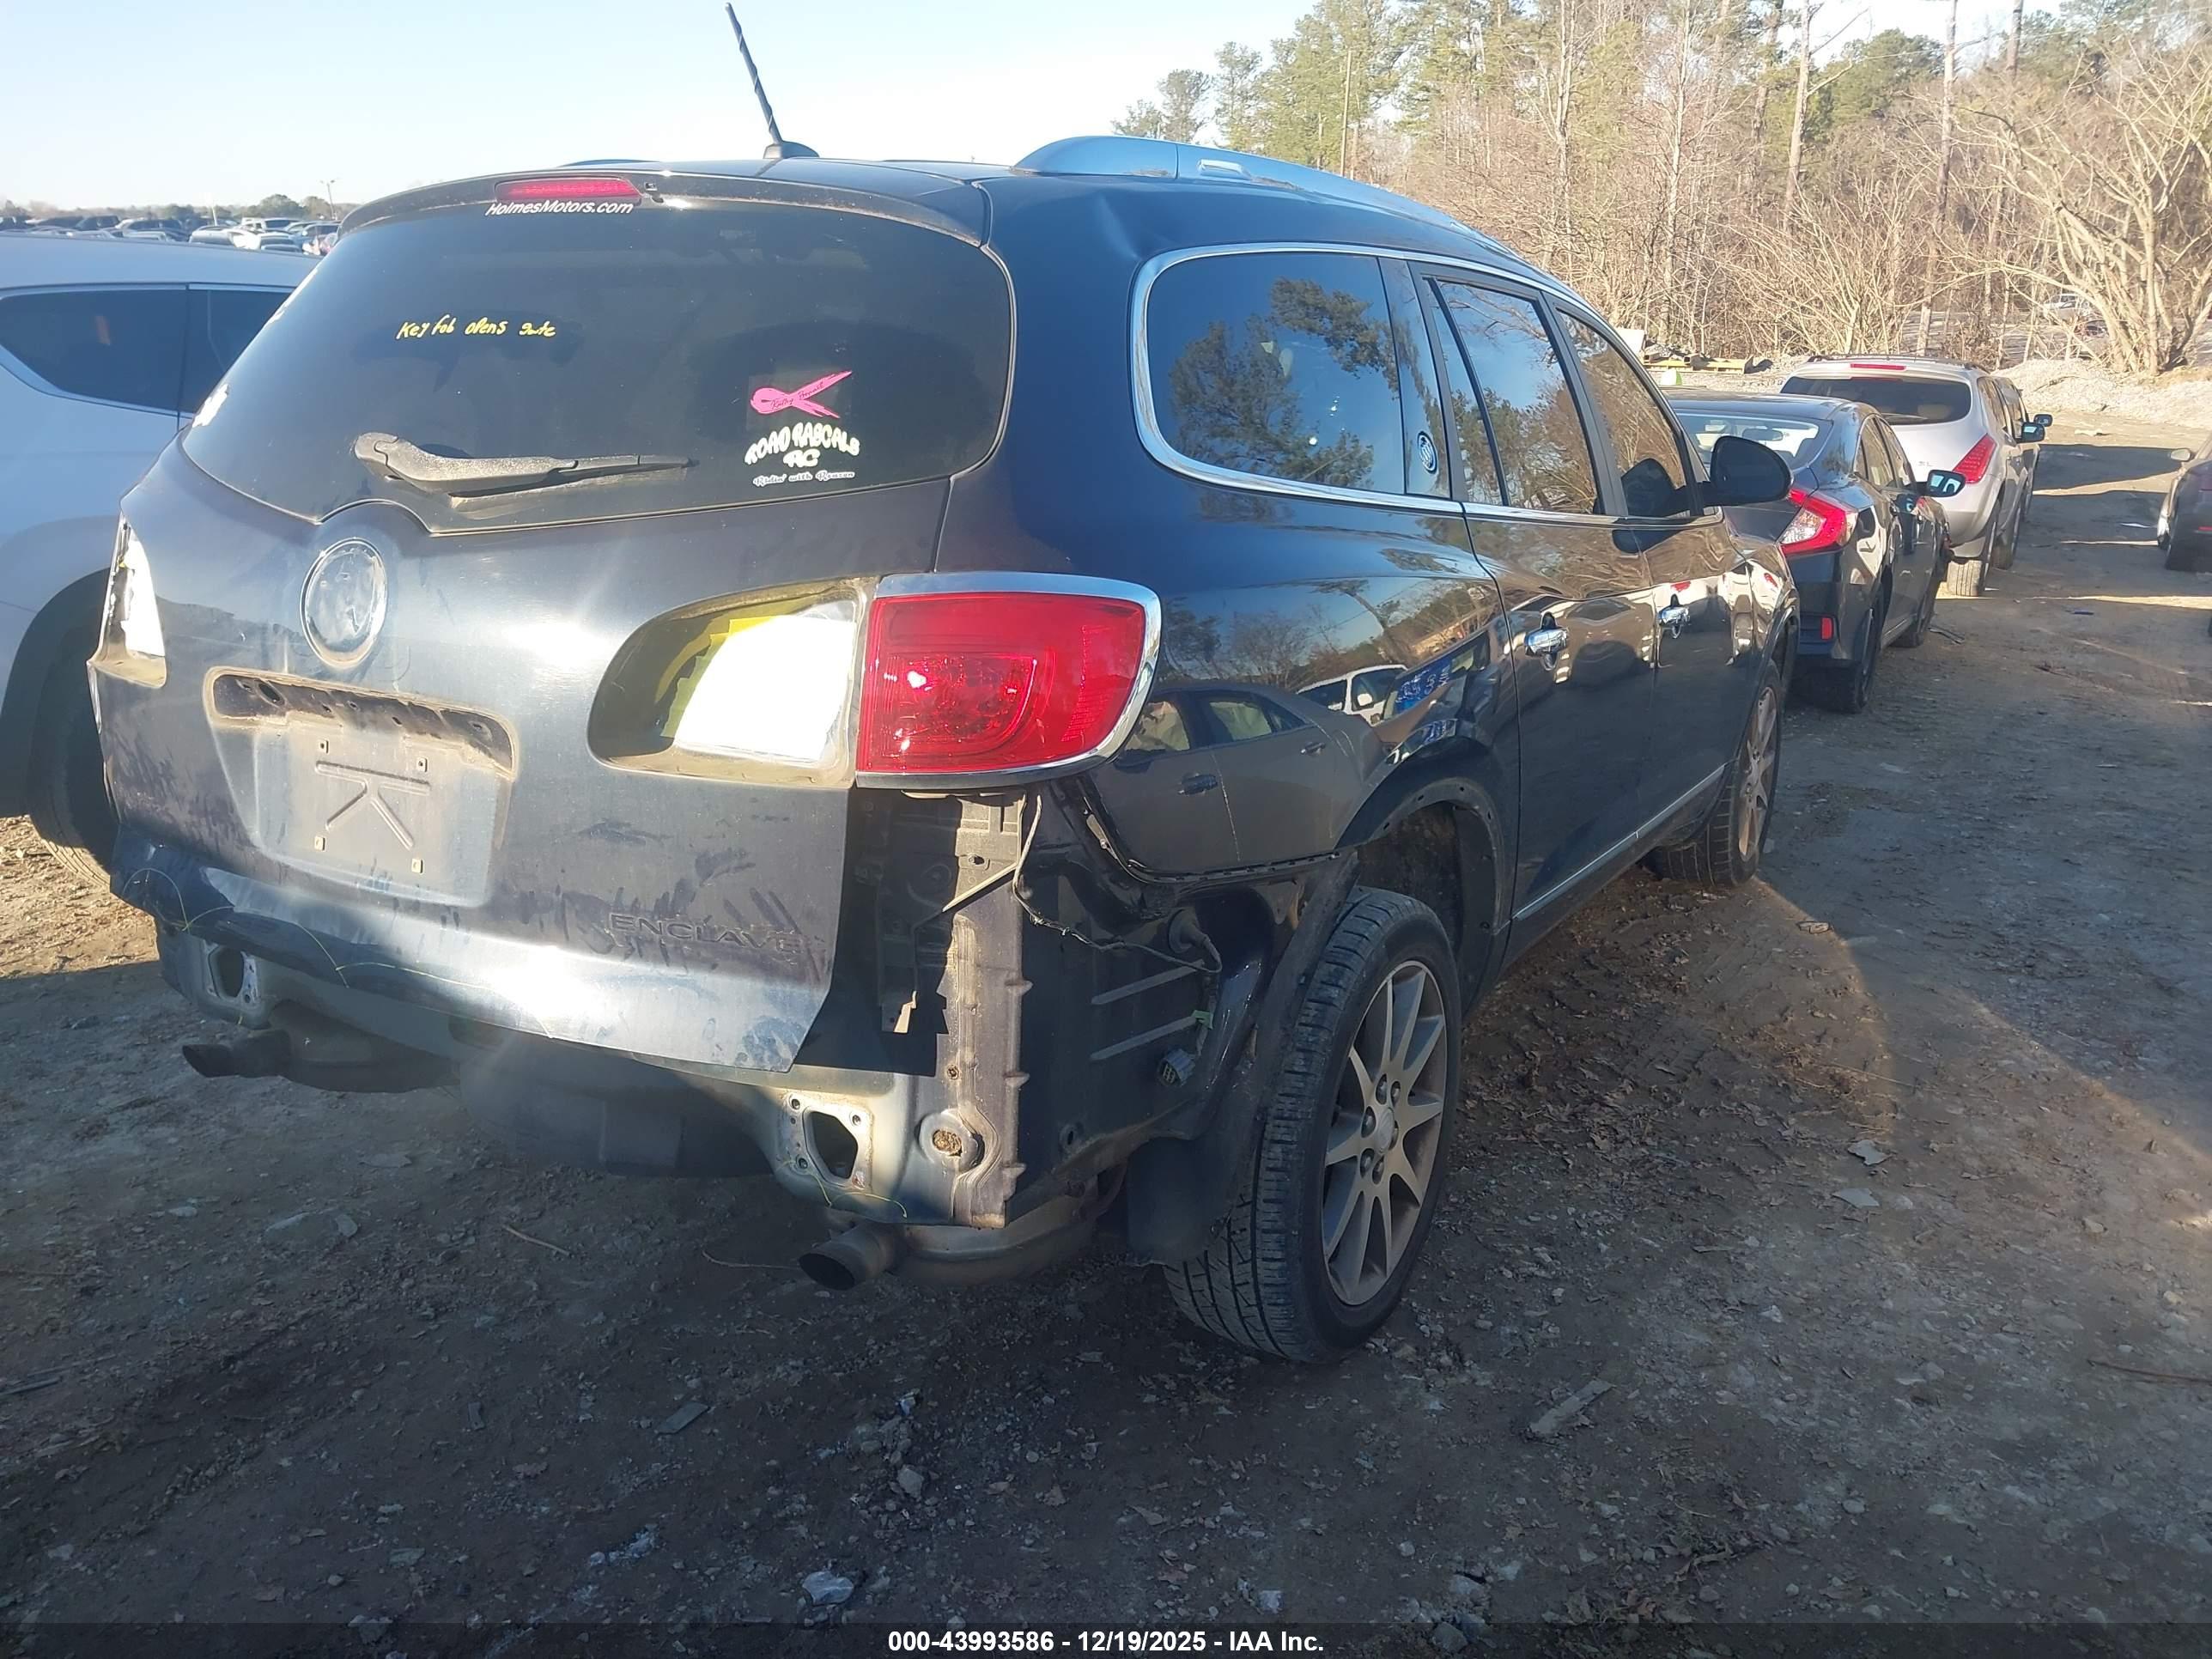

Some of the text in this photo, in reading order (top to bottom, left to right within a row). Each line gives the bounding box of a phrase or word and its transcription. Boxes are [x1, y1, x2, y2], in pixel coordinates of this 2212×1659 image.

[485, 200, 634, 216] HolmesMotors.com
[395, 321, 430, 340] Key
[431, 314, 457, 336] fob
[519, 321, 556, 337] gate
[744, 422, 860, 465] ROAD RASCALS
[788, 471, 813, 482] with
[609, 913, 805, 954] ENCLAVE
